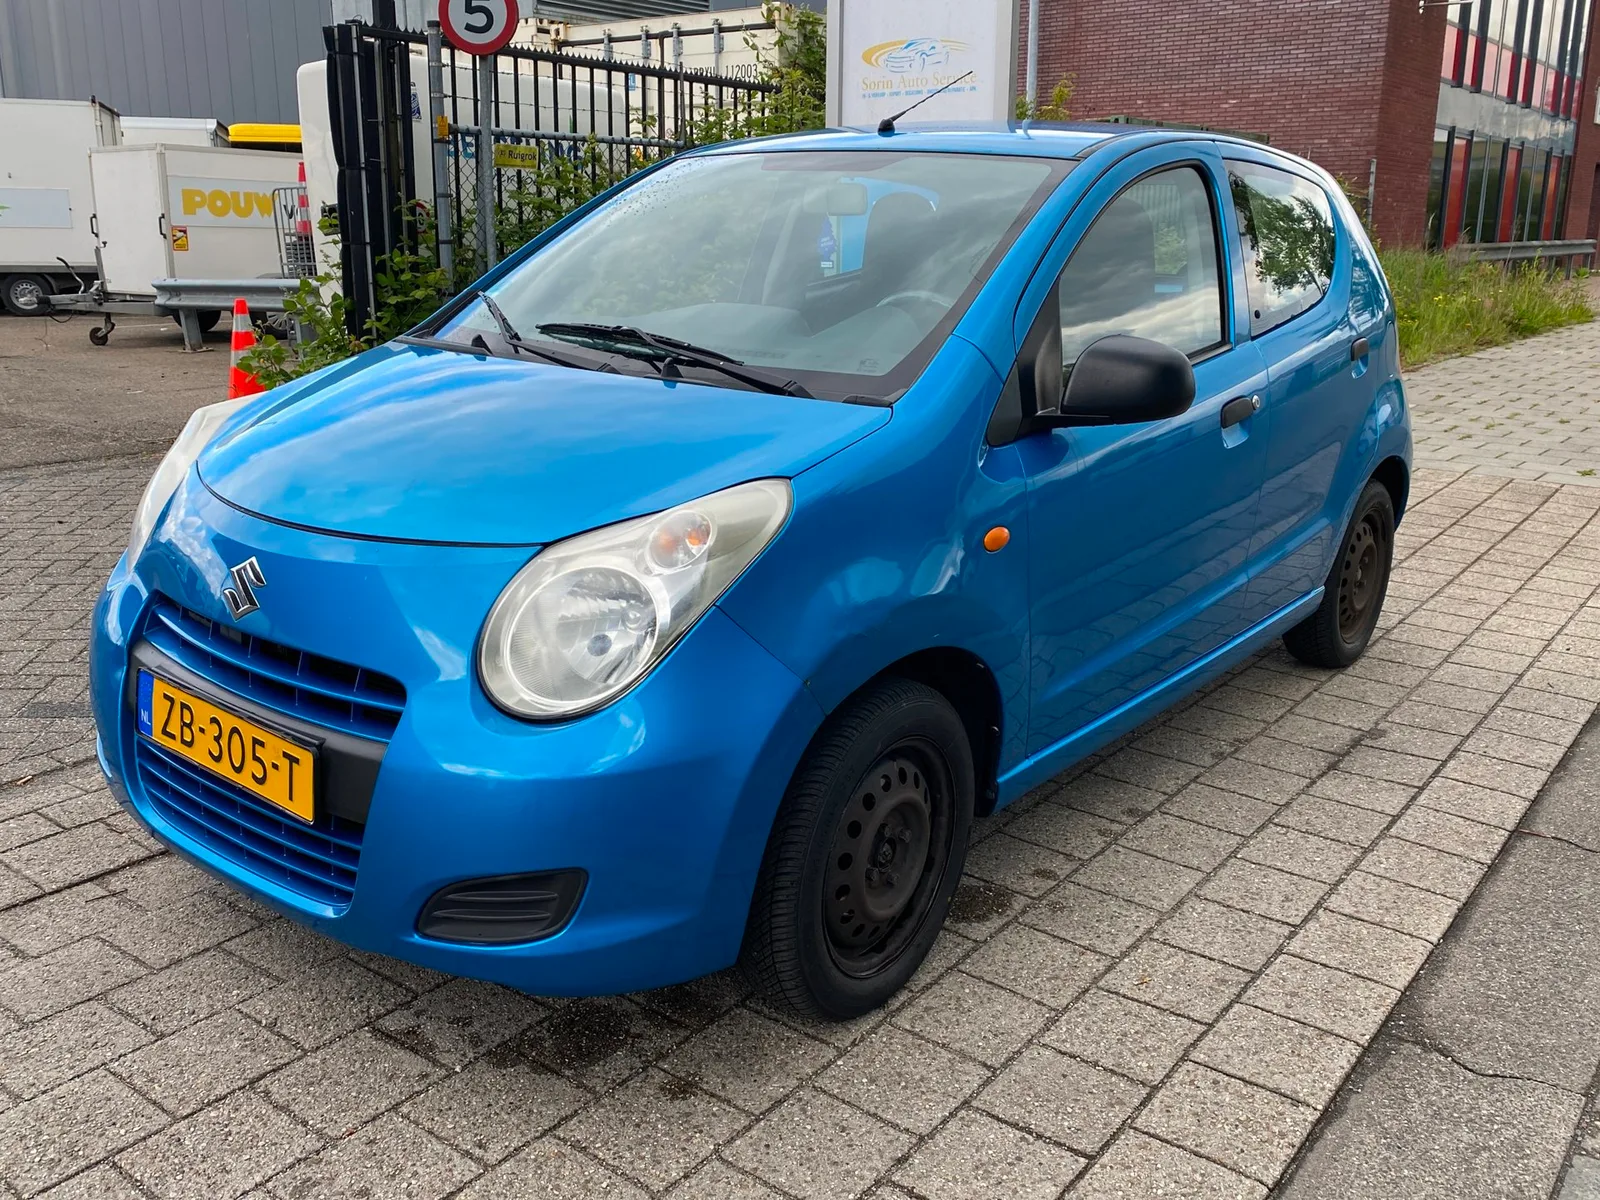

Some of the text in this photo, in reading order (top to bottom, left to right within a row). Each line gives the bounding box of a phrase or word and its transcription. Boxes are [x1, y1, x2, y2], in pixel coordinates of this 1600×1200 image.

[464, 0, 494, 34] 5
[862, 71, 977, 90] Sorin Auto Service
[508, 150, 537, 162] Ruigrok
[140, 692, 300, 802] NL ZB-305-T
